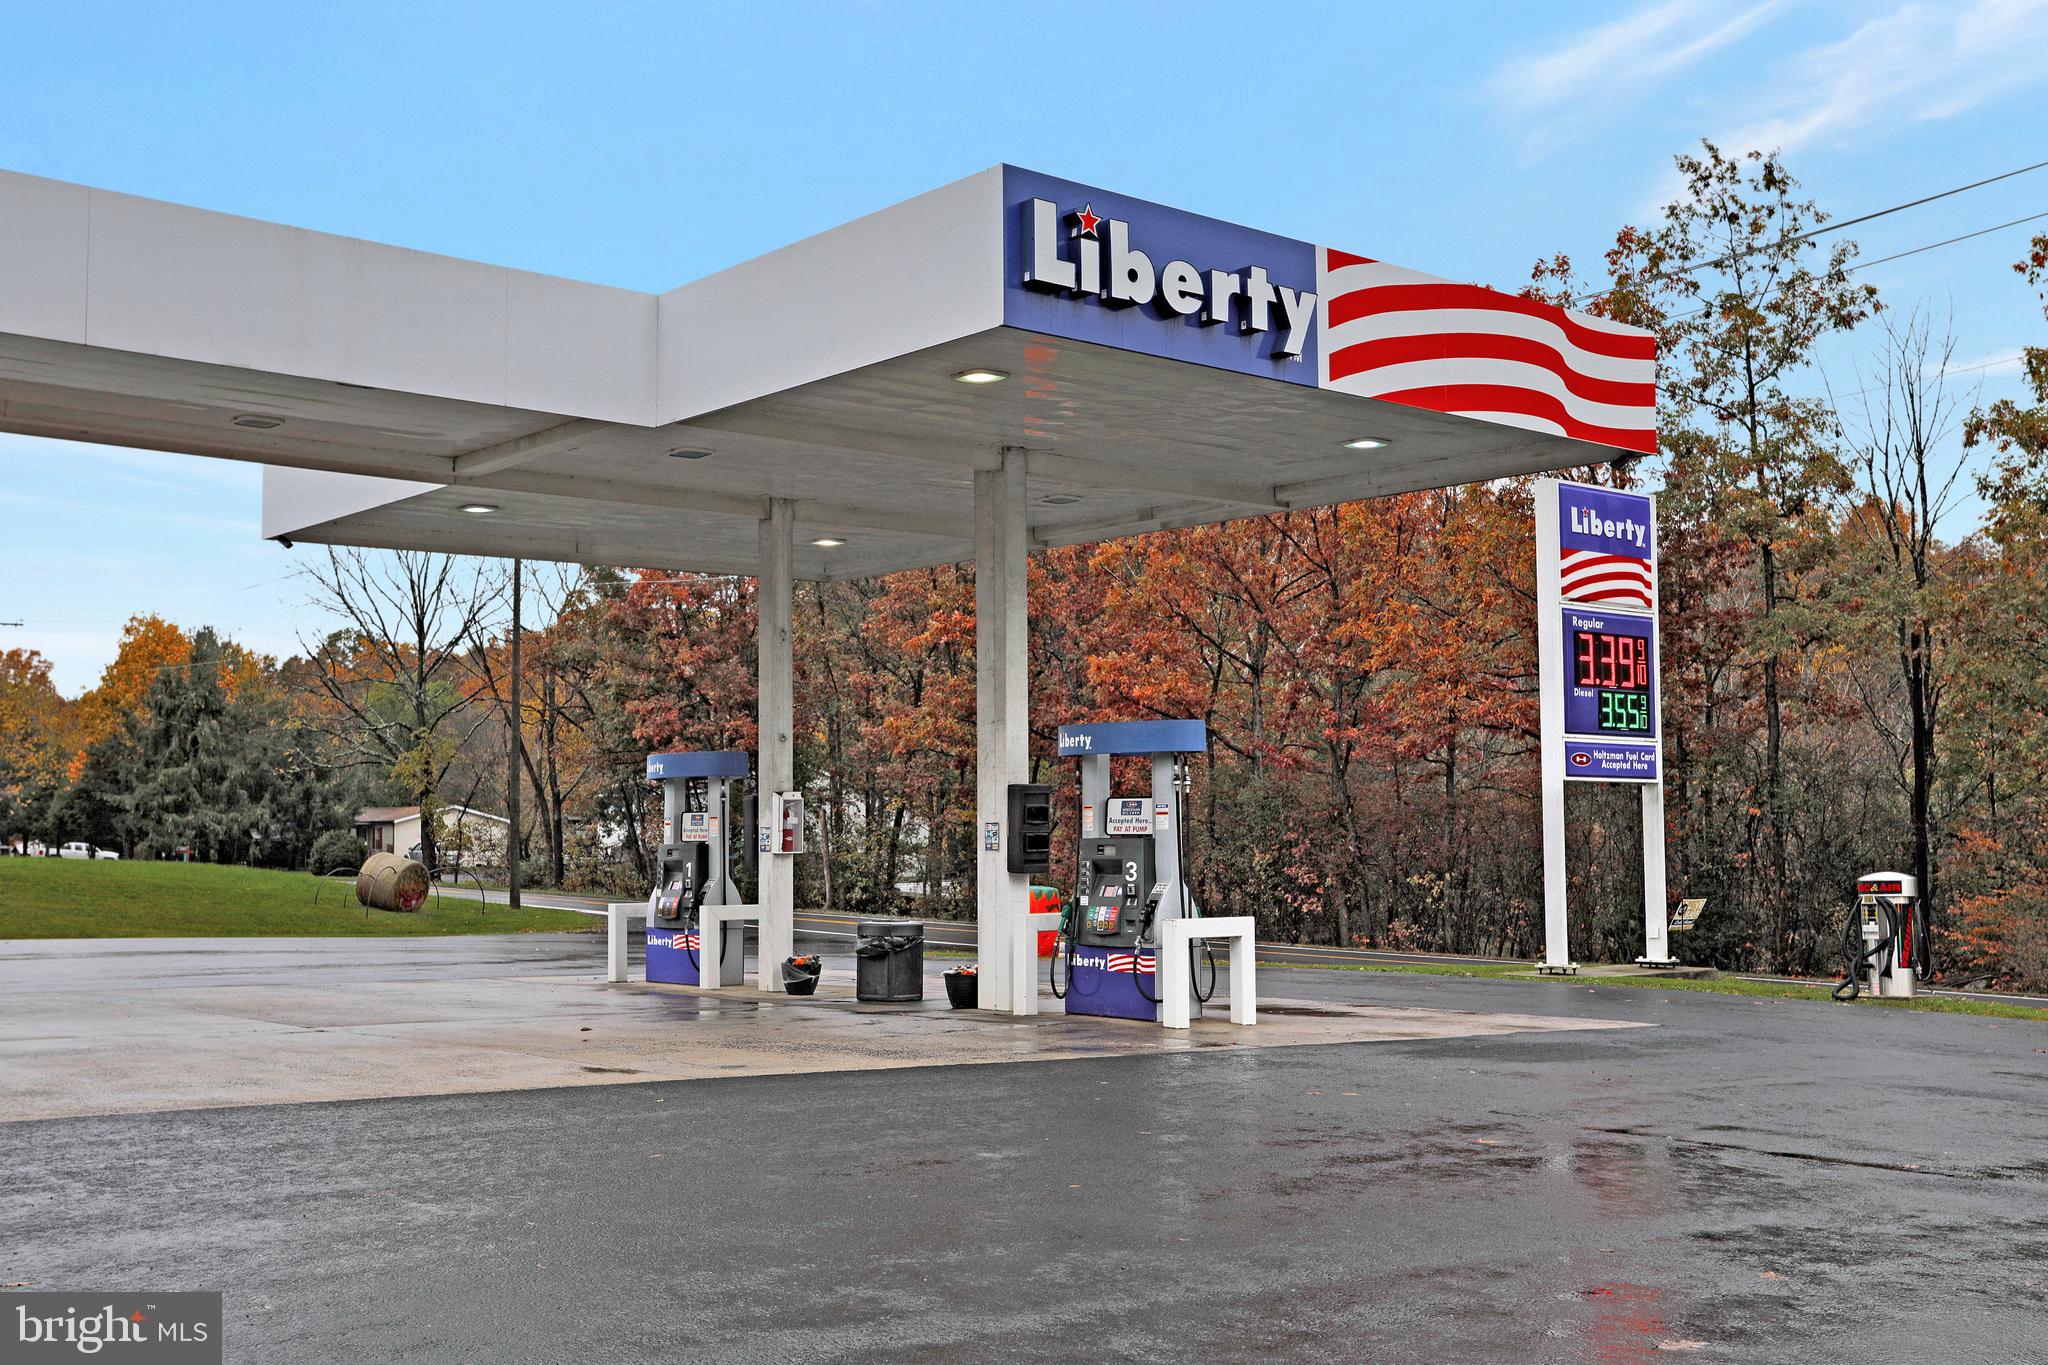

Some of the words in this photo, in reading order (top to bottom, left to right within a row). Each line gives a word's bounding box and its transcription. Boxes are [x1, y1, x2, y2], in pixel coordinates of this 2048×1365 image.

[1022, 197, 1318, 356] Liberty
[1570, 506, 1646, 547] Liberty
[1572, 616, 1604, 630] Regular
[1579, 633, 1635, 688] 3.39
[1573, 688, 1594, 698] Diesel
[1602, 692, 1640, 729] 3.55
[1059, 732, 1091, 750] Liberty
[1593, 750, 1624, 760] Holtzman
[1626, 751, 1638, 761] Fuel
[1641, 752, 1655, 761] Card
[1601, 759, 1631, 771] Accepted
[1633, 761, 1648, 770] Here
[1109, 817, 1134, 825] Accepted
[685, 862, 692, 878] 1
[1125, 861, 1138, 882] 3
[1870, 883, 1878, 892] &
[1879, 883, 1901, 892] AIR
[647, 934, 672, 949] Liberty
